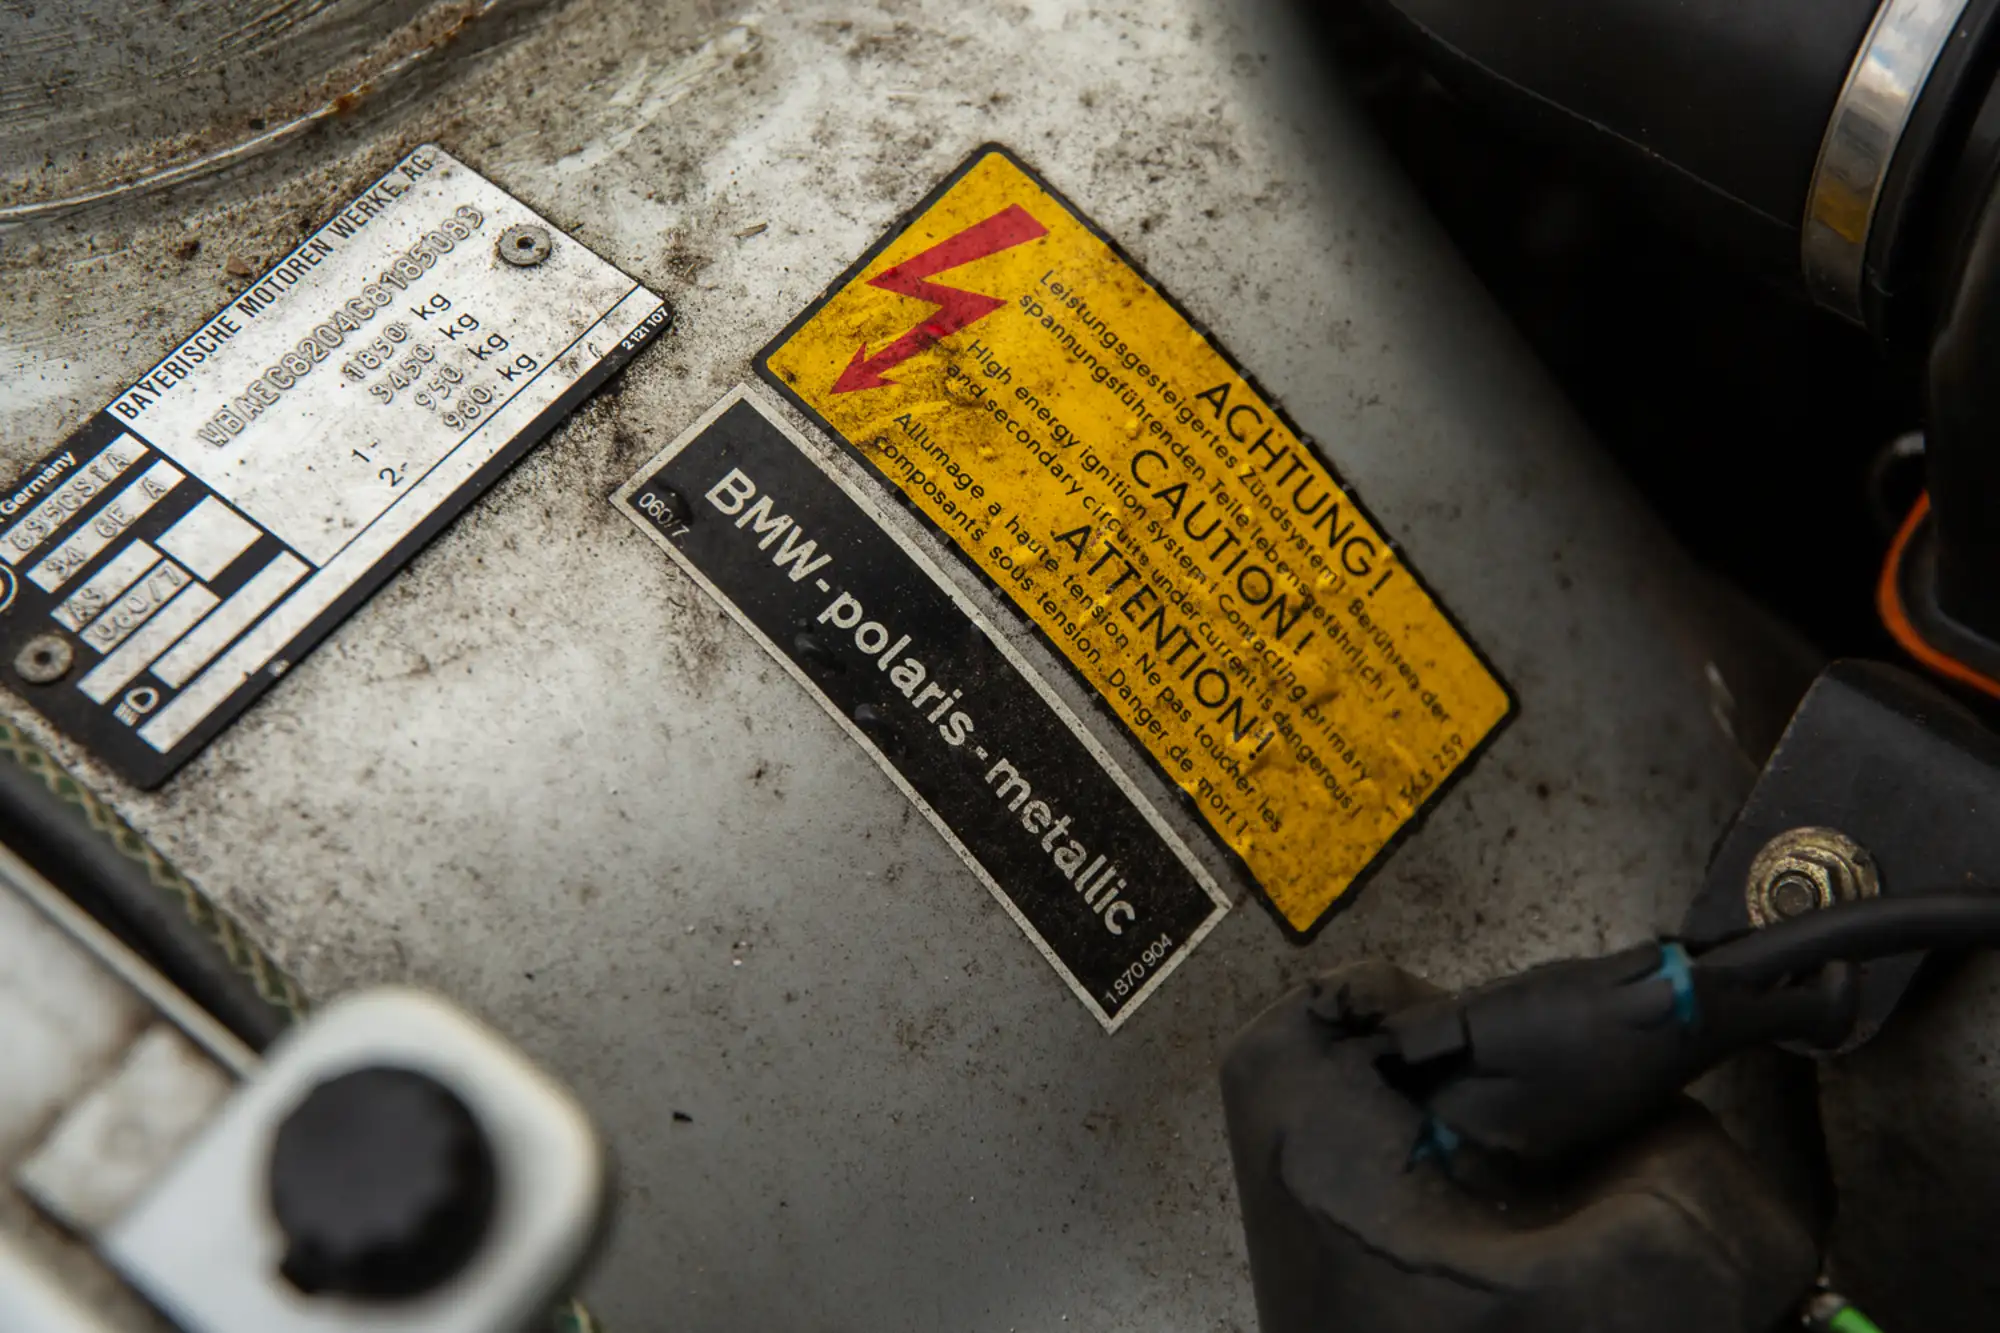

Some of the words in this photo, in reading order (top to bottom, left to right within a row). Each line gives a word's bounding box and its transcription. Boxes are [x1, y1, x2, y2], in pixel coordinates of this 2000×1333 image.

[236, 237, 334, 318] MOTOREN
[328, 180, 401, 239] WERKE
[400, 154, 434, 182] AG
[343, 323, 407, 380] 1850
[410, 293, 451, 321] kg
[438, 313, 480, 341] kg
[646, 306, 668, 327] 107
[414, 364, 464, 411] 950
[467, 333, 509, 361] kg
[443, 385, 493, 431] 980
[496, 353, 538, 382] kg
[1019, 294, 1206, 481] spannungsführenden
[1209, 478, 1250, 527] Teile
[0, 451, 77, 515] Germany
[141, 476, 167, 500] A
[638, 492, 690, 537] 060/7
[1040, 269, 1239, 470] Leistungsgesteigertes
[1421, 689, 1451, 724] der
[947, 364, 988, 398] and
[985, 399, 1084, 496] secondary
[1082, 495, 1149, 566] circuits
[1151, 568, 1200, 620] under
[1198, 622, 1258, 689] current
[1256, 688, 1273, 712] is
[967, 339, 1012, 385] High
[1015, 386, 1081, 449] energy
[1079, 446, 1147, 520] ignition
[1218, 594, 1307, 702] Contacting
[1301, 703, 1372, 786] primary
[873, 435, 985, 542] composants
[989, 545, 1034, 592] sous
[1108, 668, 1169, 741] Danger
[1169, 746, 1193, 773] de
[893, 413, 985, 499] Allumage
[988, 501, 1002, 517] a
[1004, 513, 1060, 573] haute
[1134, 651, 1161, 686] Ne
[1156, 686, 1192, 723] pas
[1194, 723, 1256, 797] toucher
[1257, 798, 1282, 833] les
[704, 467, 1135, 935] BMW-polaris-metallic
[1114, 961, 1145, 998] 870
[1141, 932, 1173, 966] 904
